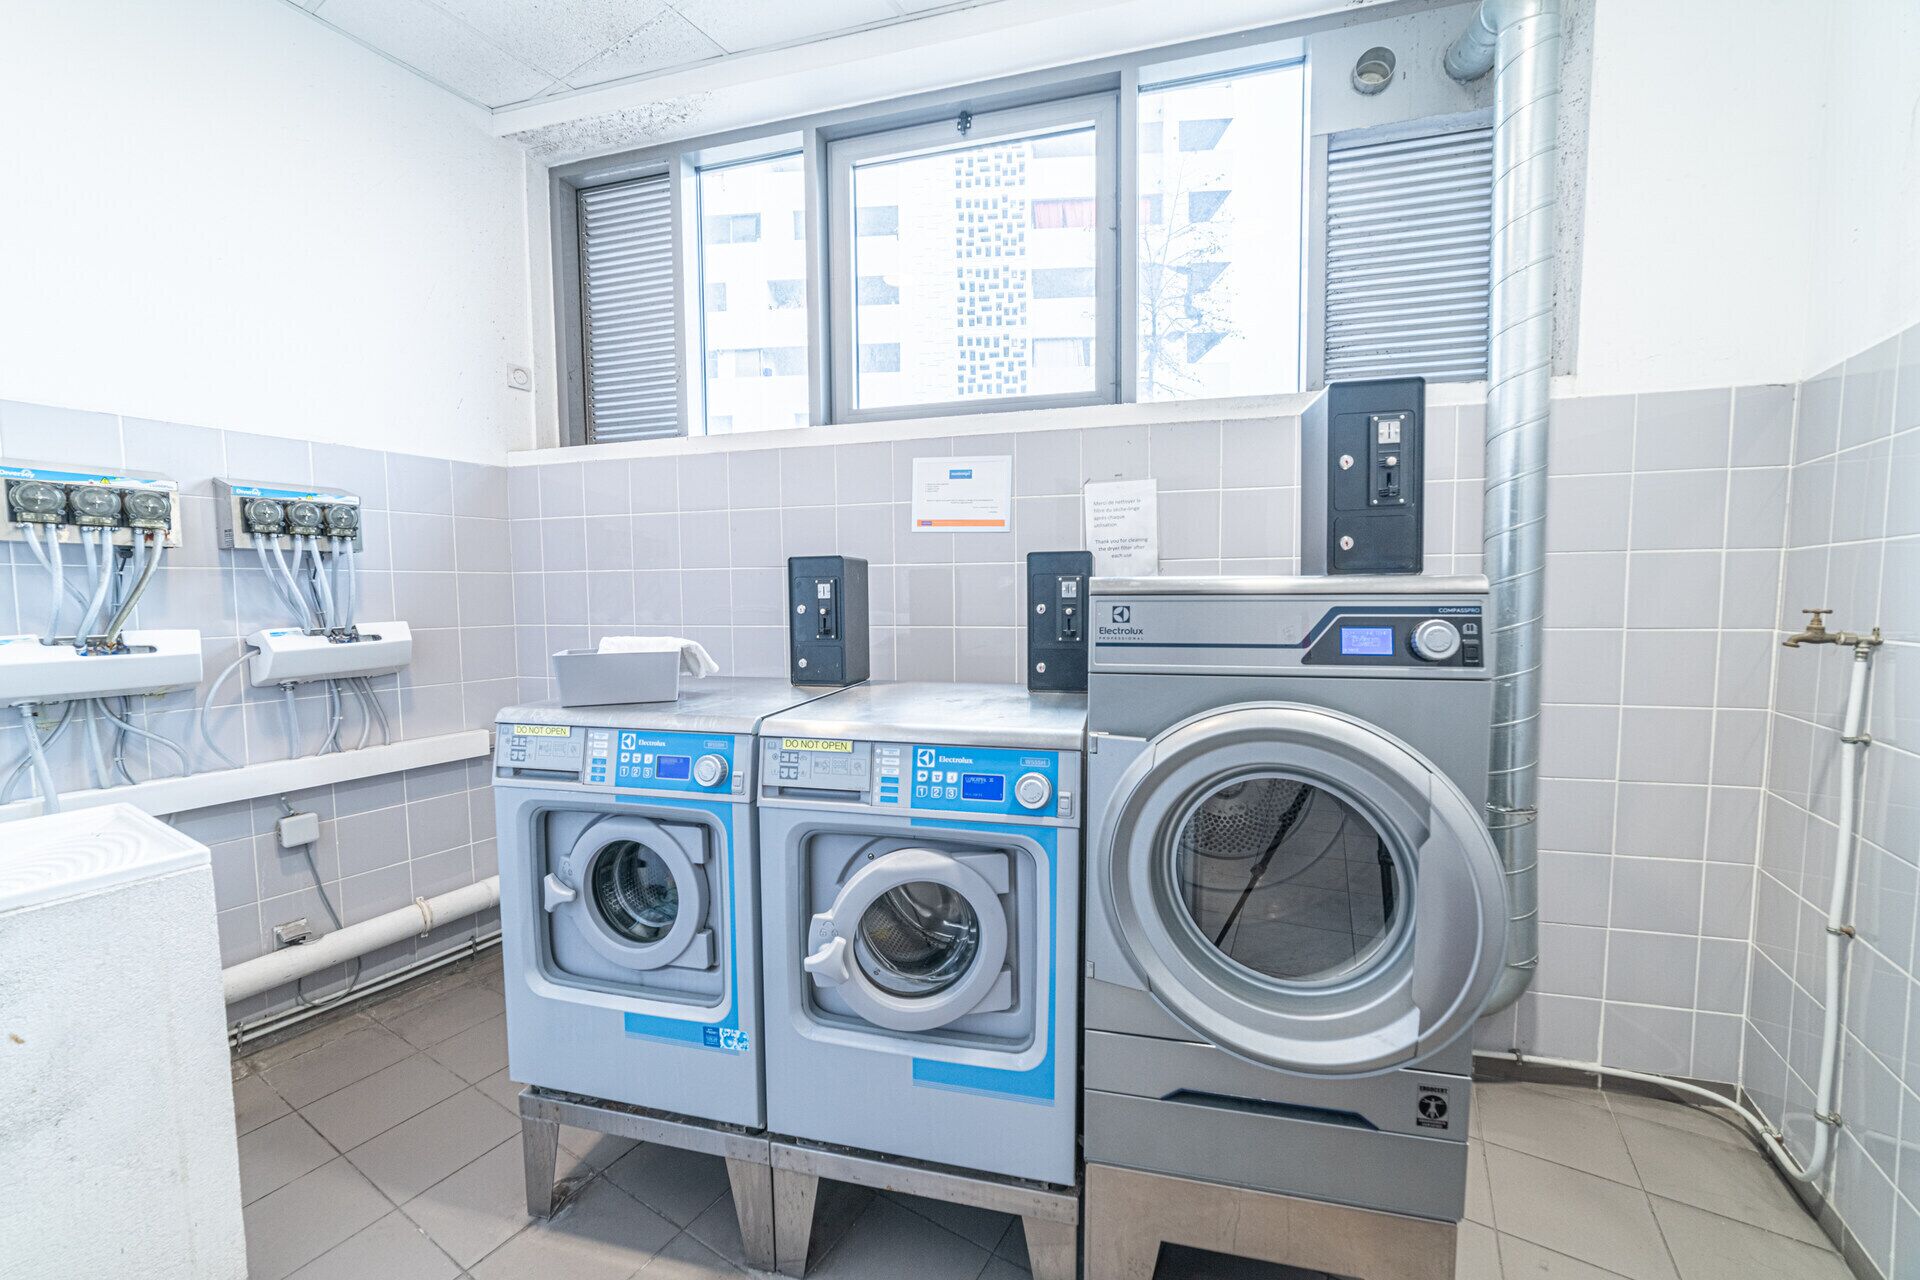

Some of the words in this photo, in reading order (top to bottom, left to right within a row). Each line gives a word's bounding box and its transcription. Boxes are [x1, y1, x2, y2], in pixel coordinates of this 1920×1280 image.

[1099, 626, 1143, 635] Electrolux
[516, 725, 528, 734] DO
[528, 726, 544, 735] NOT
[545, 727, 567, 736] OPEN
[638, 738, 666, 747] Electrolux
[785, 739, 799, 748] DO
[800, 740, 819, 749] NOT
[821, 740, 848, 750] OPEN
[938, 755, 974, 764] Electrolux
